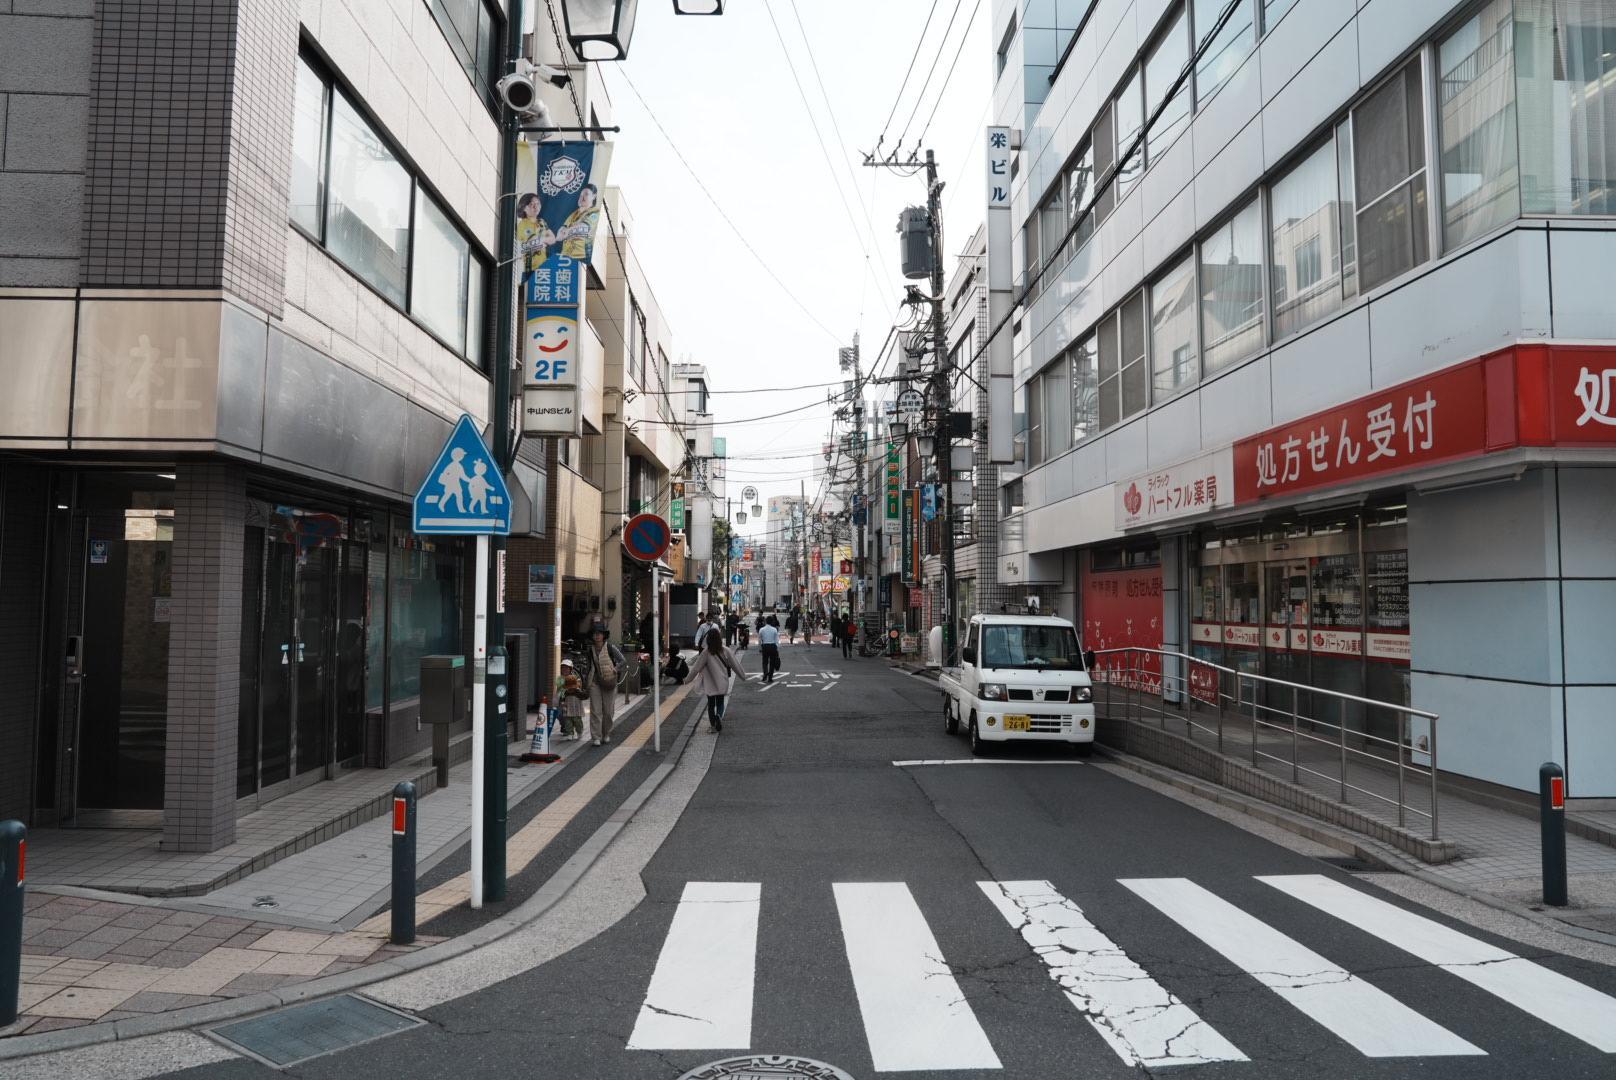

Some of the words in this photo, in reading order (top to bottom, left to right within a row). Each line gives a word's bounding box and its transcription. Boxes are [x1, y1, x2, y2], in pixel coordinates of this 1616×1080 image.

[990, 131, 1008, 203] 栄ビル
[534, 268, 551, 302] 医院
[534, 359, 568, 380] 2F
[527, 407, 572, 416] 中山NSビル
[1573, 366, 1616, 427] 処
[1256, 390, 1437, 489] 処方せん受付
[1147, 474, 1170, 492] ライラック
[1147, 475, 1217, 515] ハートフル薬局
